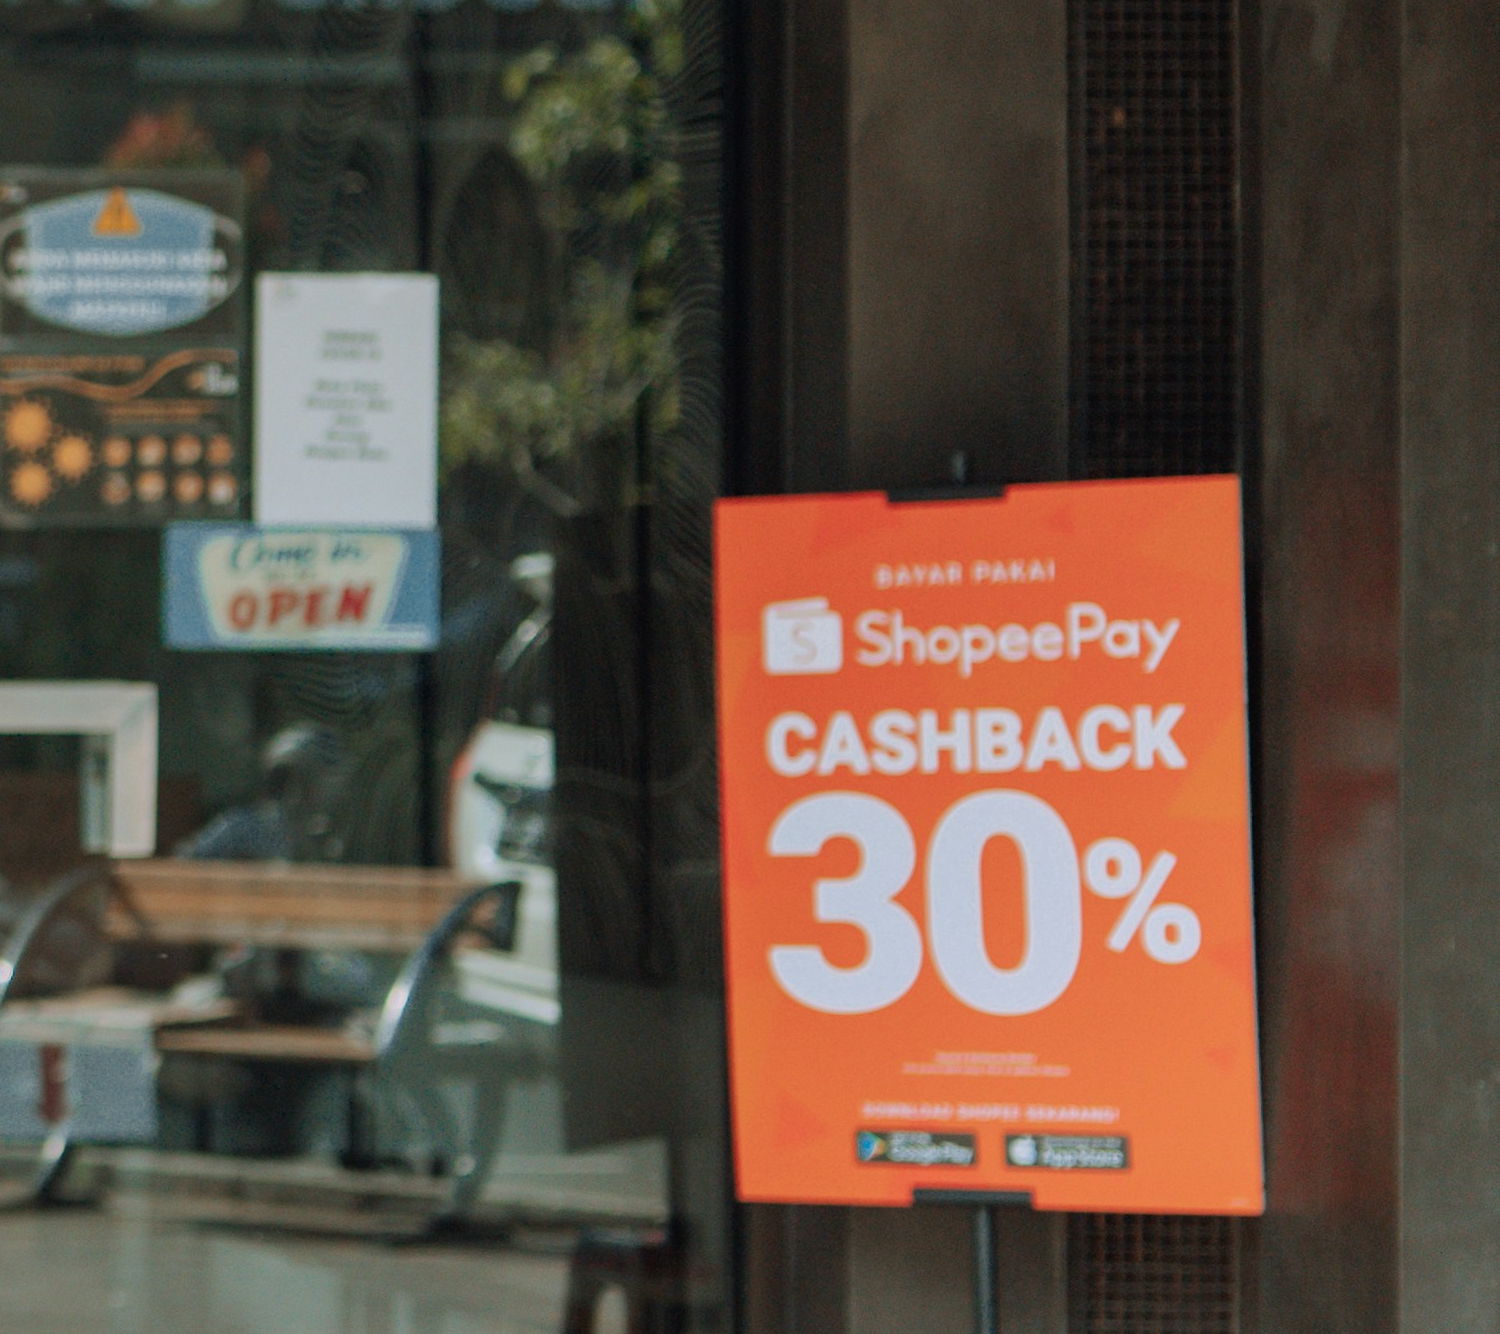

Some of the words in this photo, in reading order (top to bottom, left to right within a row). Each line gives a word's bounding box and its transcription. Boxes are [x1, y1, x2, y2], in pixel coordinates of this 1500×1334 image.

[227, 581, 376, 633] OPEN
[874, 560, 963, 590] BAYAR
[971, 556, 1056, 585] PAKAI
[854, 601, 1181, 679] ShopeePay
[764, 702, 1189, 779] CASHBACK
[767, 788, 1203, 1017] 30%
